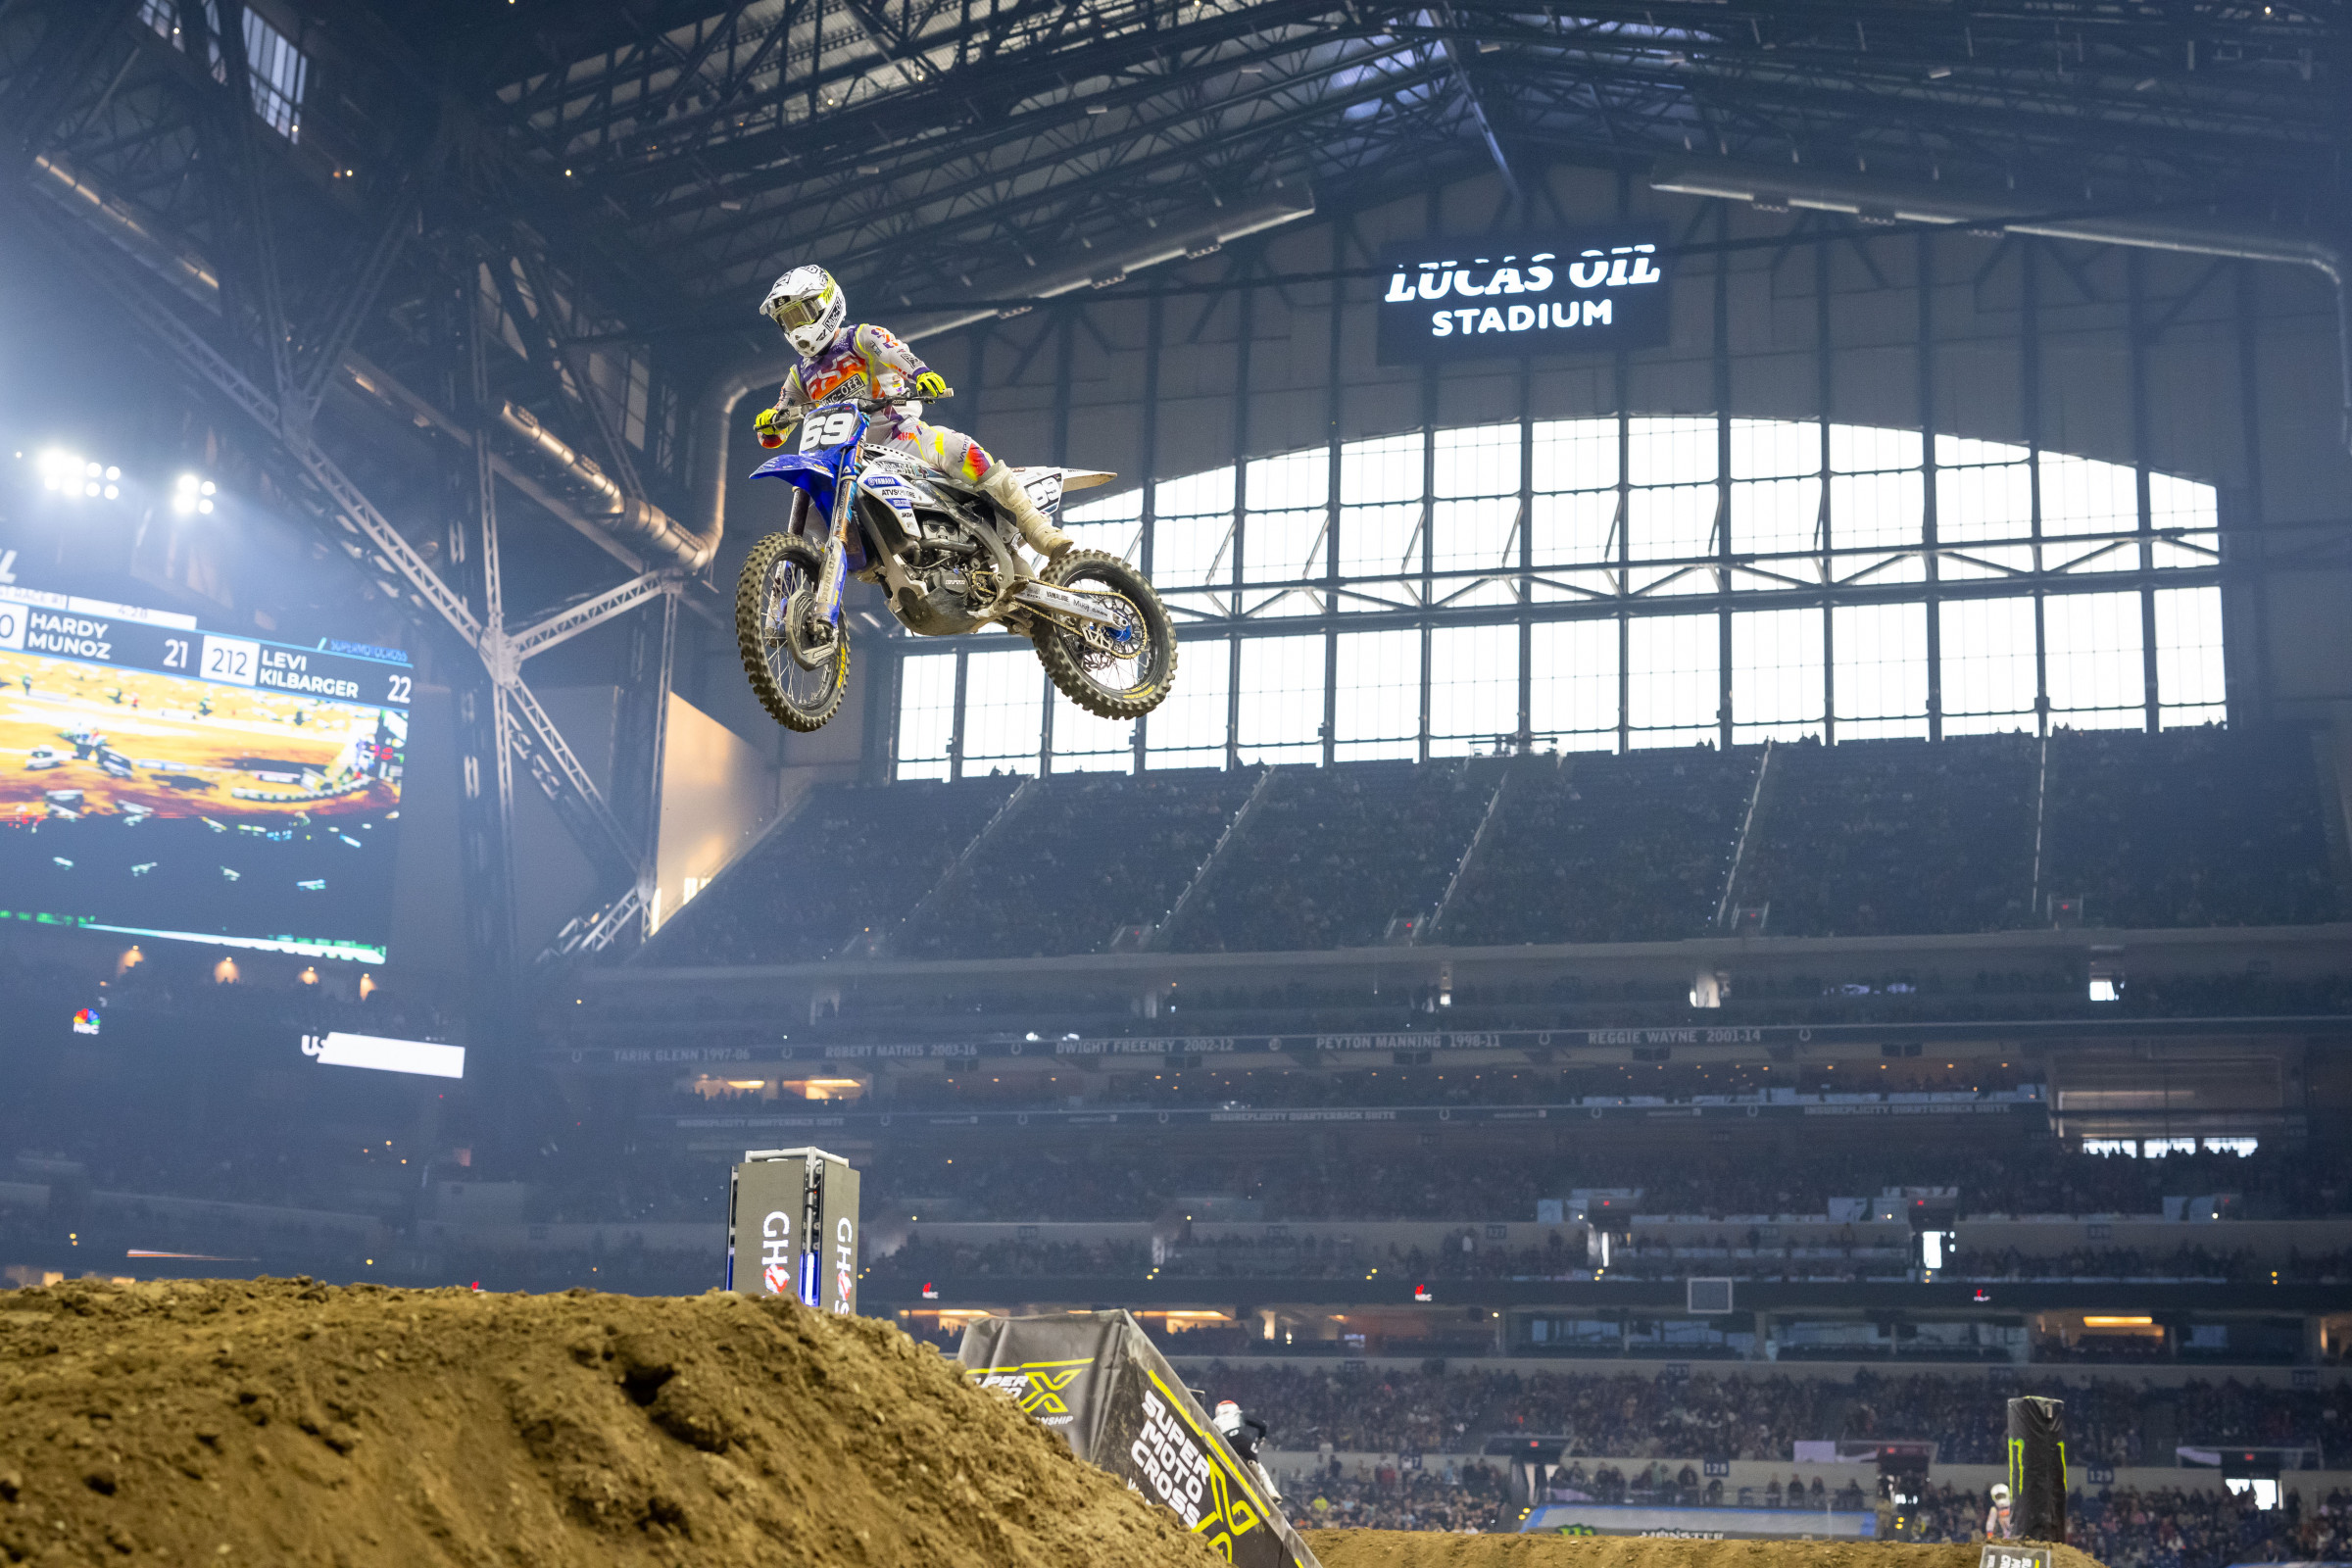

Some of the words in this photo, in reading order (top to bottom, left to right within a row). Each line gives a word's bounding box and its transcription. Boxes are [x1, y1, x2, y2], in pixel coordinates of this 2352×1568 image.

[1384, 252, 1555, 303] LUCAS
[1569, 243, 1662, 288] OIL
[1432, 298, 1613, 337] STADIUM
[800, 413, 855, 451] 69
[1026, 476, 1061, 509] 69
[29, 612, 109, 639] HARDY
[27, 631, 112, 661] MUNOZ
[163, 638, 189, 669] 21
[261, 649, 308, 672] LEVI
[211, 648, 248, 676] 212
[259, 668, 359, 699] KILBARGER
[386, 674, 413, 705] 22
[825, 1045, 873, 1057] ROBERT
[876, 1044, 924, 1057] MATHIS
[930, 1043, 978, 1056] 2003-16
[1055, 1041, 1108, 1054] DWIGHT
[1112, 1040, 1175, 1054] FREENEY
[1183, 1039, 1234, 1052] 2002-12
[1316, 1036, 1371, 1050] PEYTON
[1374, 1035, 1442, 1049] MANNING
[1449, 1035, 1500, 1048] 1998-11
[1588, 1031, 1641, 1045] REGGIE
[1646, 1030, 1697, 1044] WAYNE
[1706, 1030, 1761, 1043] 2001-14
[613, 1050, 652, 1062] TARIK
[655, 1049, 699, 1061] GLENN
[703, 1048, 751, 1060] 1997-06
[761, 1210, 791, 1298] GHO
[974, 1375, 1030, 1389] UPER
[1035, 1415, 1074, 1426] NSHIP
[1141, 1389, 1211, 1486] SUPER
[1140, 1418, 1203, 1504] MOTO
[1130, 1439, 1201, 1530] CROSS
